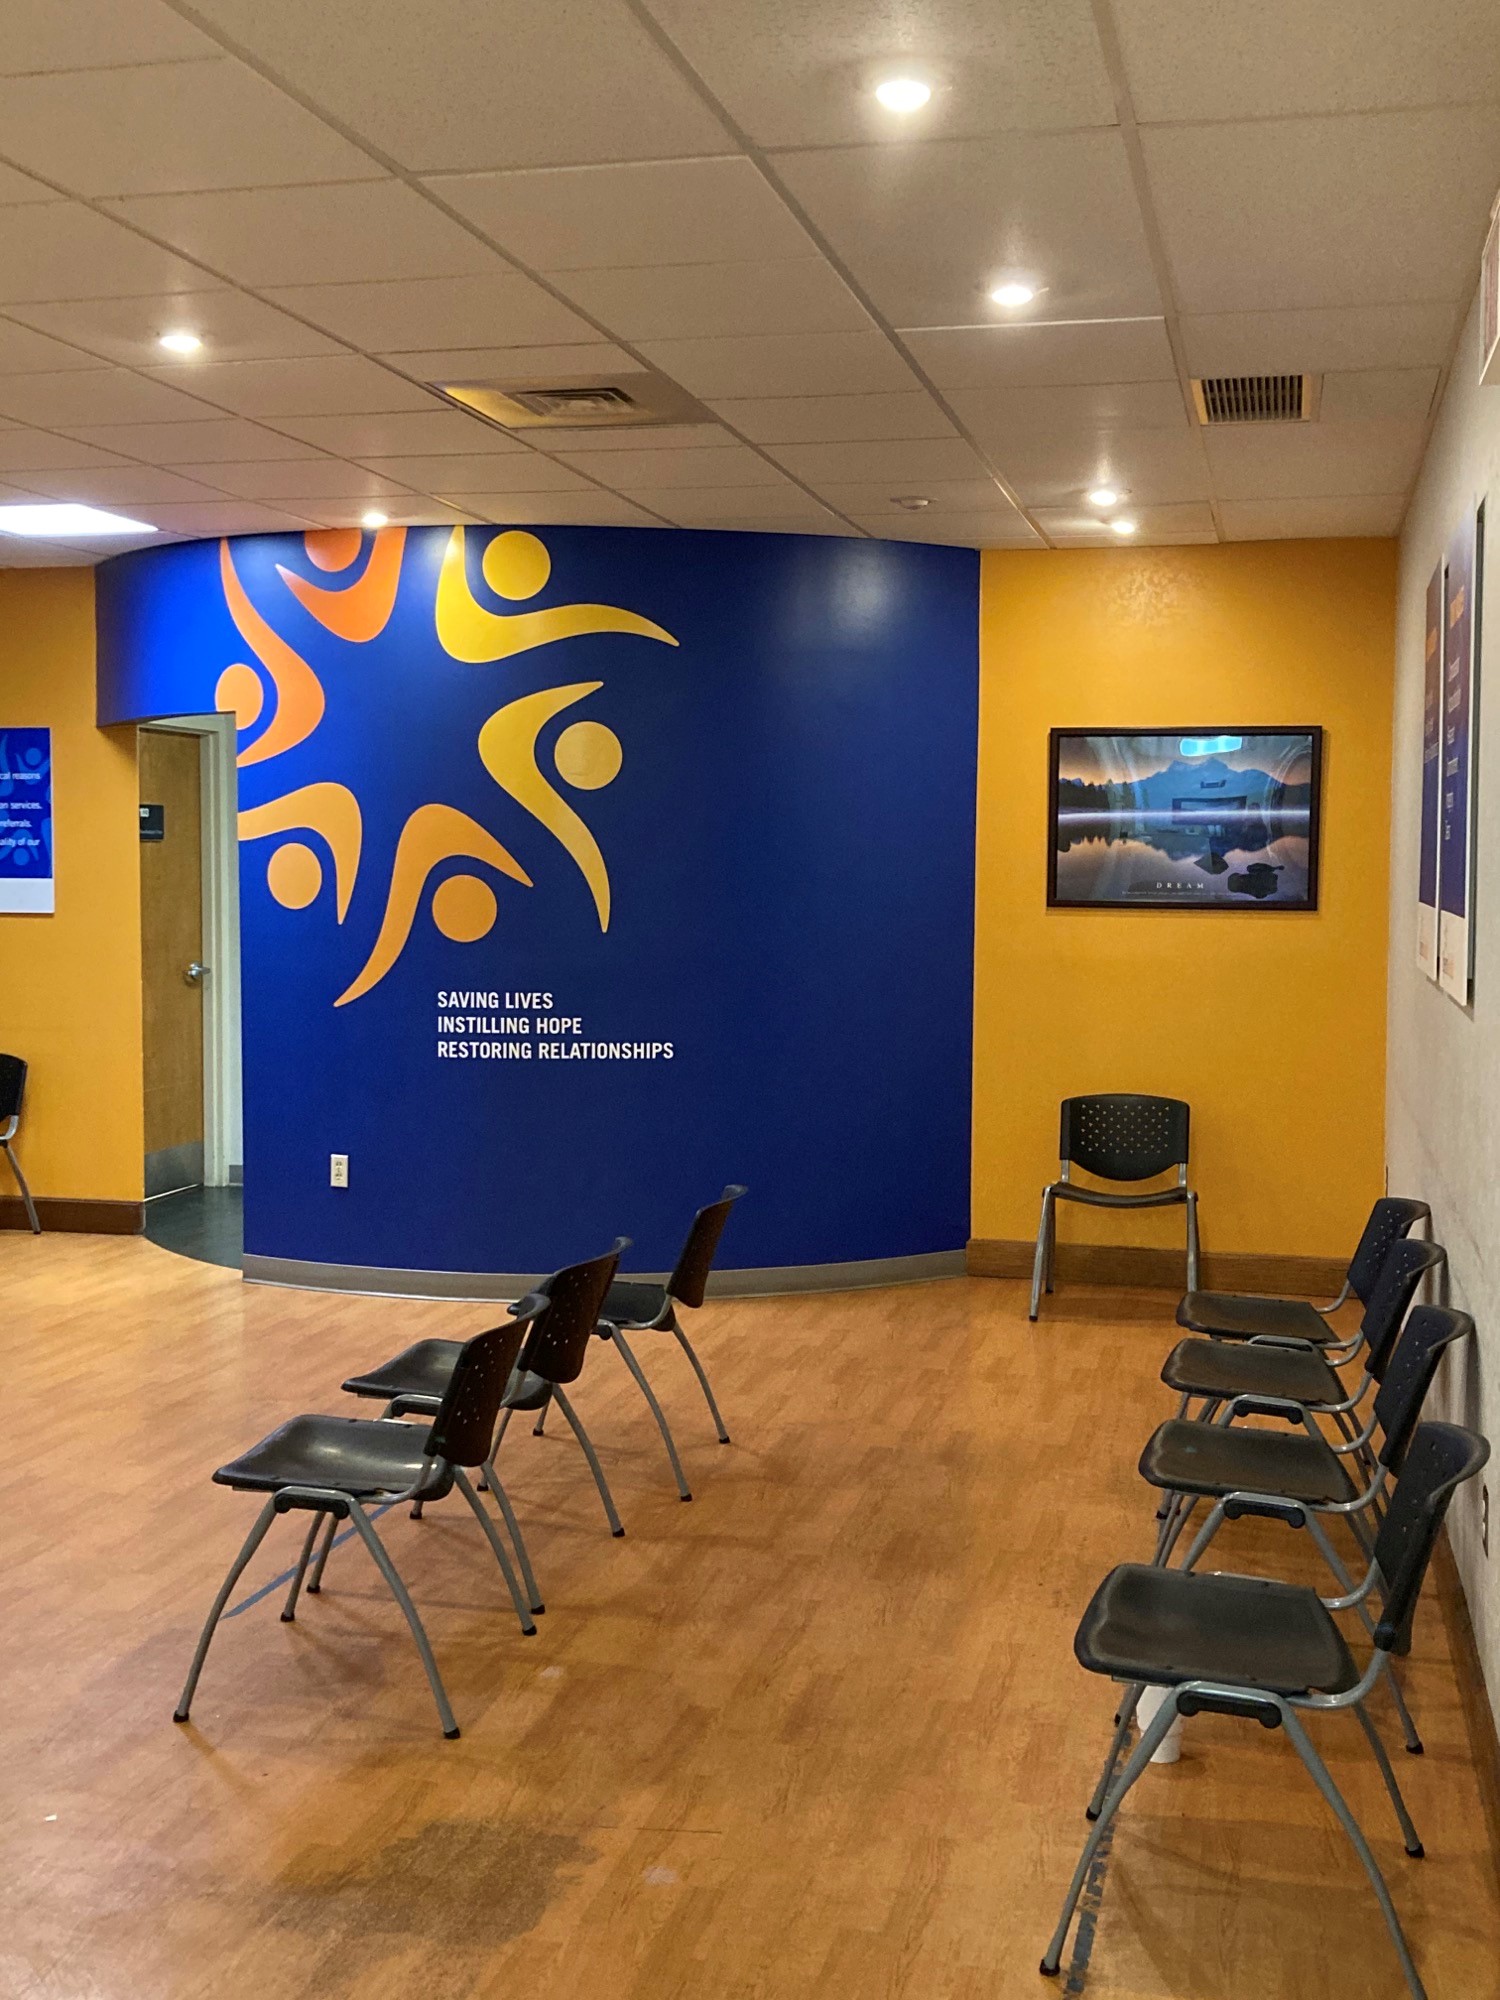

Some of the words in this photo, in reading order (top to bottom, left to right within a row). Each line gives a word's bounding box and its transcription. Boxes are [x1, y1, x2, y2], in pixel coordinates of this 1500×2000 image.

[12, 772, 41, 780] reasons
[17, 837, 26, 846] of
[438, 991, 499, 1008] SAVING
[506, 992, 553, 1009] LIVES
[438, 1016, 529, 1034] INSTILLING
[537, 1018, 582, 1034] HOPE
[438, 1041, 531, 1059] RESTORING
[539, 1043, 673, 1059] RELATIONSHIPS
